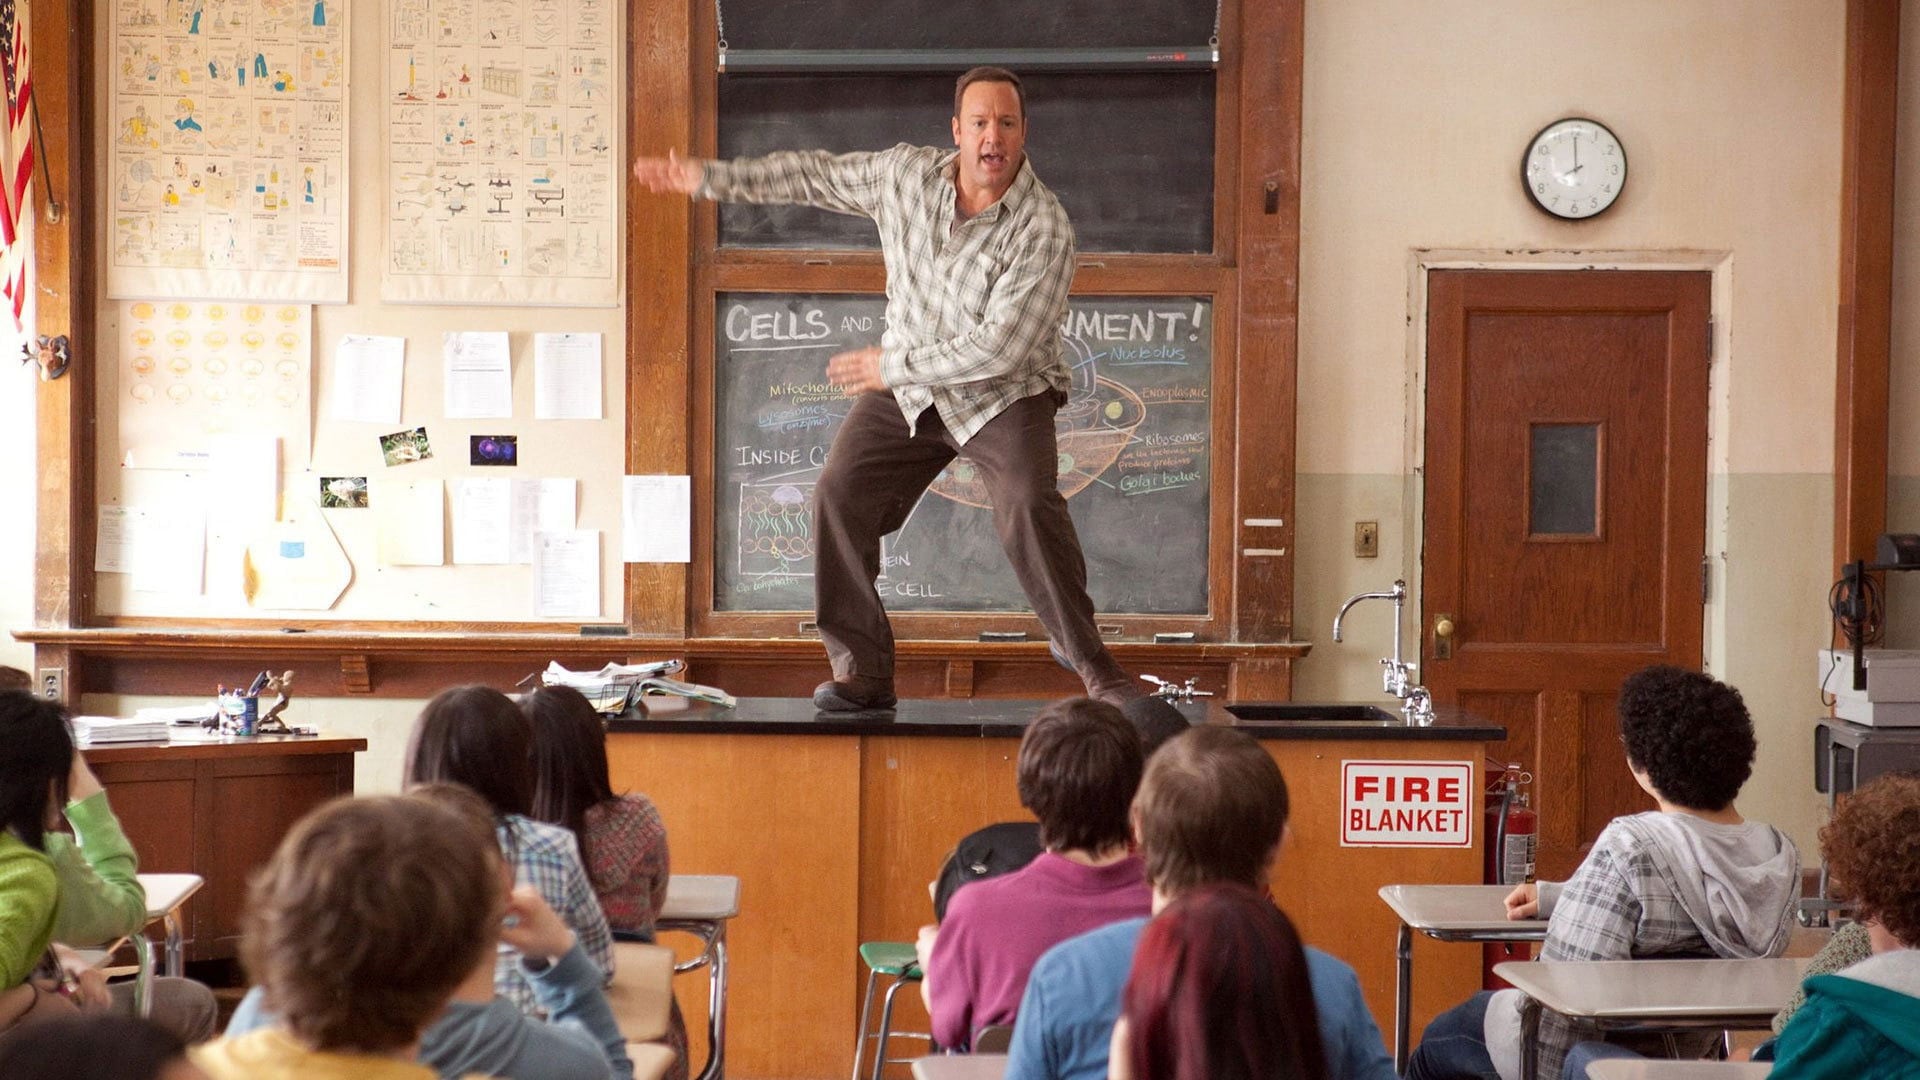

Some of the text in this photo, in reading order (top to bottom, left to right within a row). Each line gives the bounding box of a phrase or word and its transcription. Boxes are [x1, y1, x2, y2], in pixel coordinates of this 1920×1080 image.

[1611, 164, 1619, 176] 3
[1537, 182, 1545, 194] 8
[1570, 203, 1579, 214] 6
[725, 304, 832, 342] CELLS
[840, 315, 873, 332] AND
[1109, 344, 1186, 361] Nucleolus
[1144, 432, 1205, 446] Ribosomes
[736, 446, 801, 466] INSIDE
[1120, 471, 1201, 491] Golgi bodies
[896, 582, 944, 598] CELL
[1354, 776, 1460, 802] FIRE
[1350, 808, 1463, 833] BLANKET
